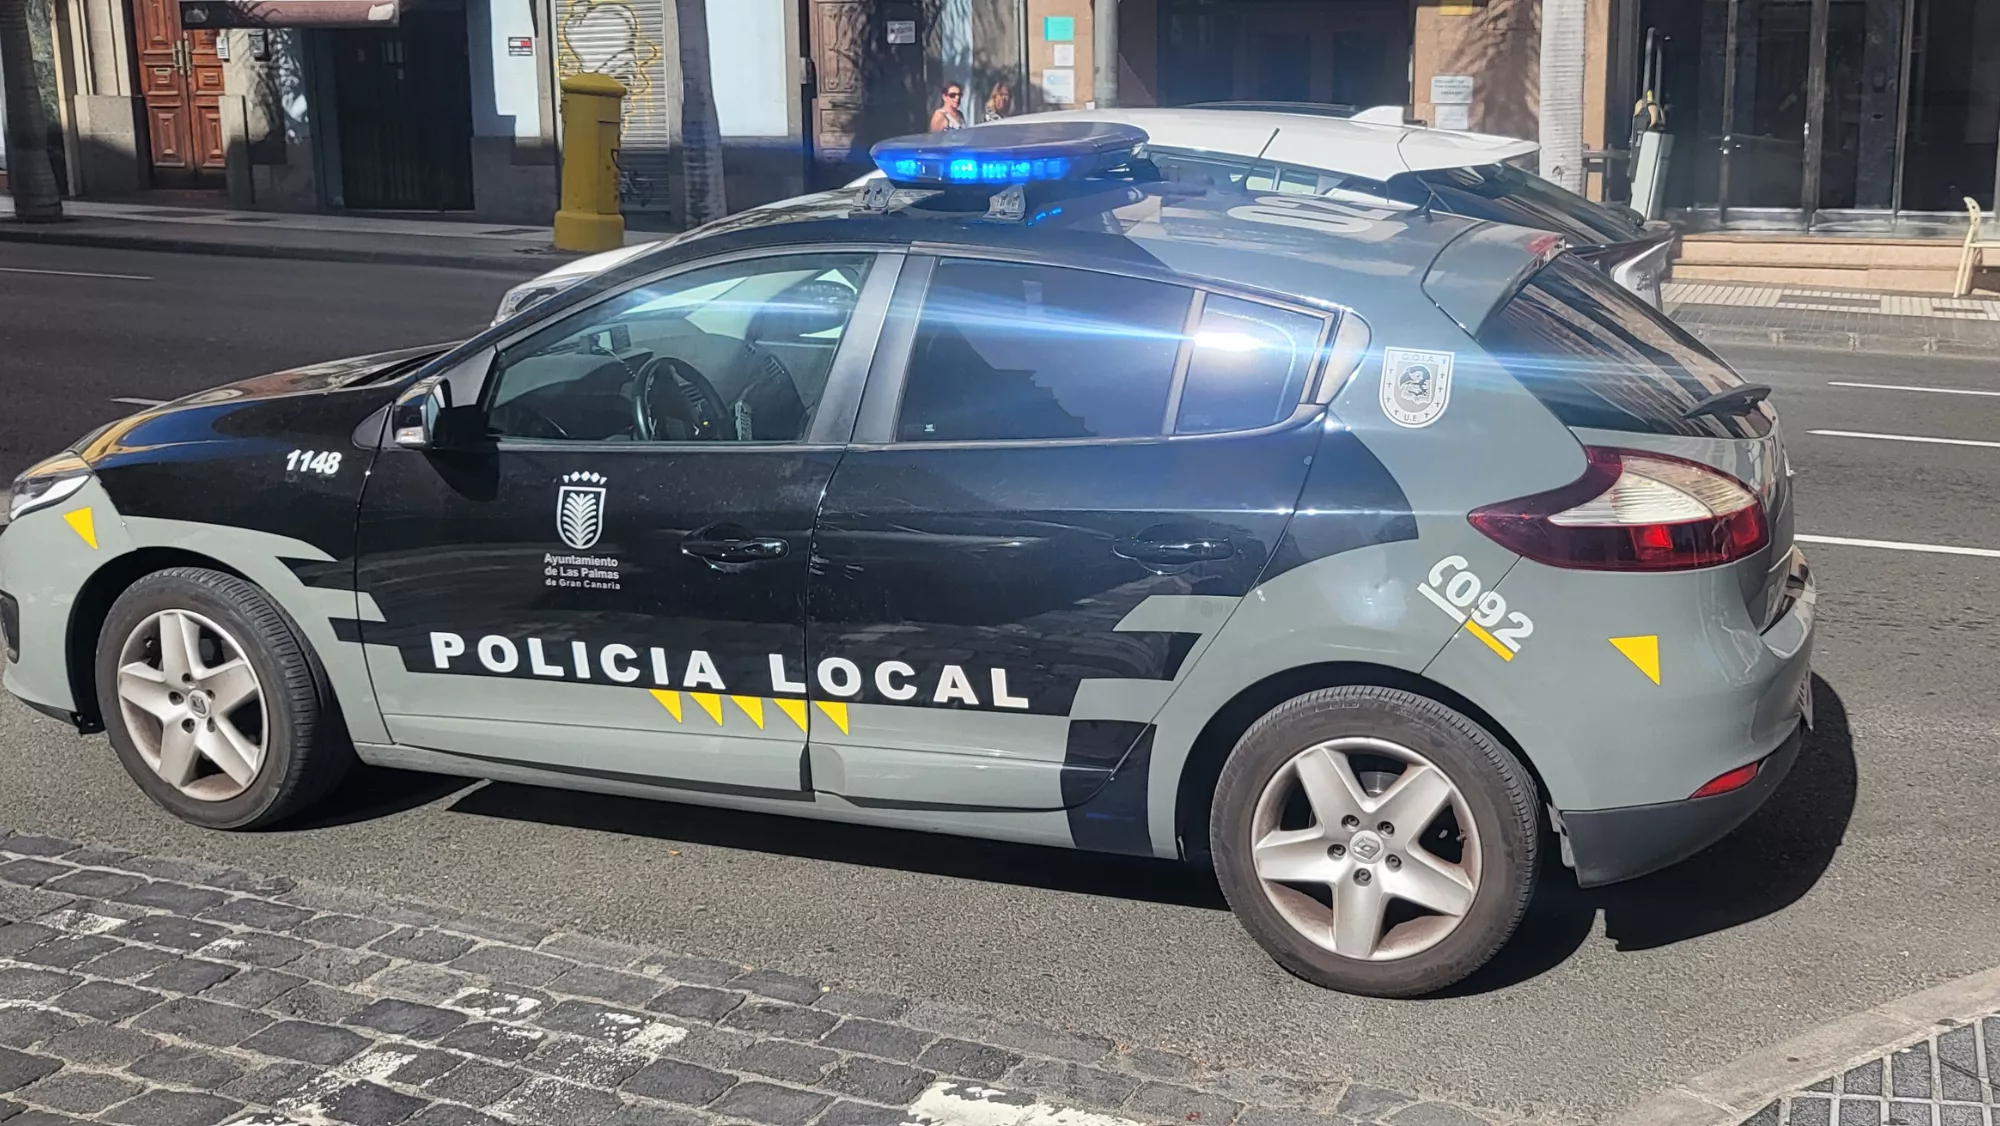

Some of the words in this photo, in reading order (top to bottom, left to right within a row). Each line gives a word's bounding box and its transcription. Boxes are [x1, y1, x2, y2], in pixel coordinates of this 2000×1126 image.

[286, 449, 342, 476] 1148
[543, 552, 619, 568] Ayuntamiento
[544, 566, 558, 576] de
[560, 567, 579, 577] Las
[581, 568, 620, 580] Palmas
[545, 578, 557, 586] de
[559, 579, 582, 588] Gran
[583, 580, 621, 590] Canaria
[430, 631, 726, 690] POLICIA
[769, 653, 1029, 709] LOCAL
